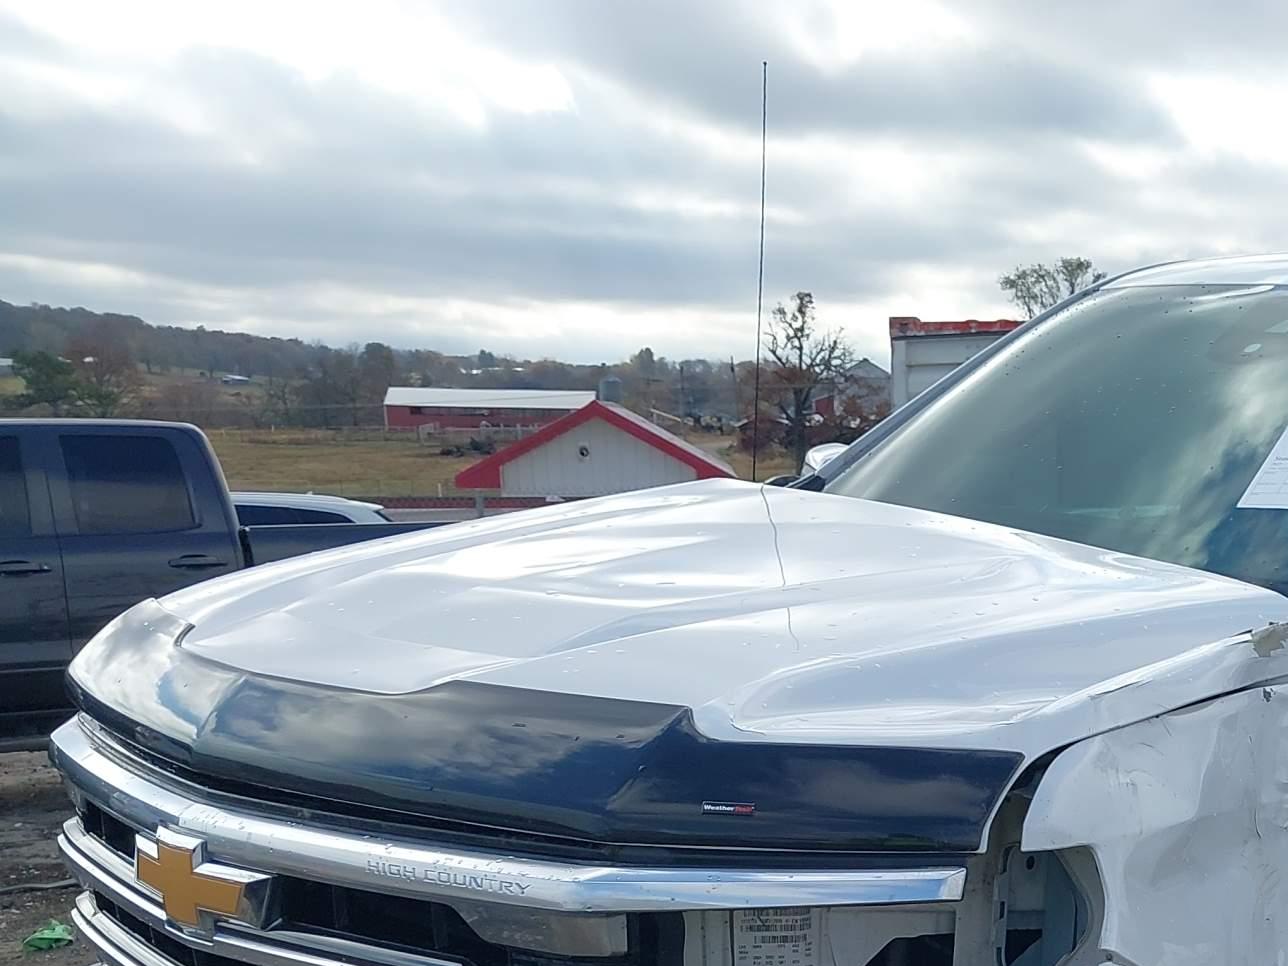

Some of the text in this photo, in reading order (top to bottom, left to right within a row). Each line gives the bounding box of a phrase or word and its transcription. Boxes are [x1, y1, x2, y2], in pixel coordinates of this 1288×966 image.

[704, 804, 753, 813] Weather
[366, 860, 531, 896] HIGH COUNTRY
